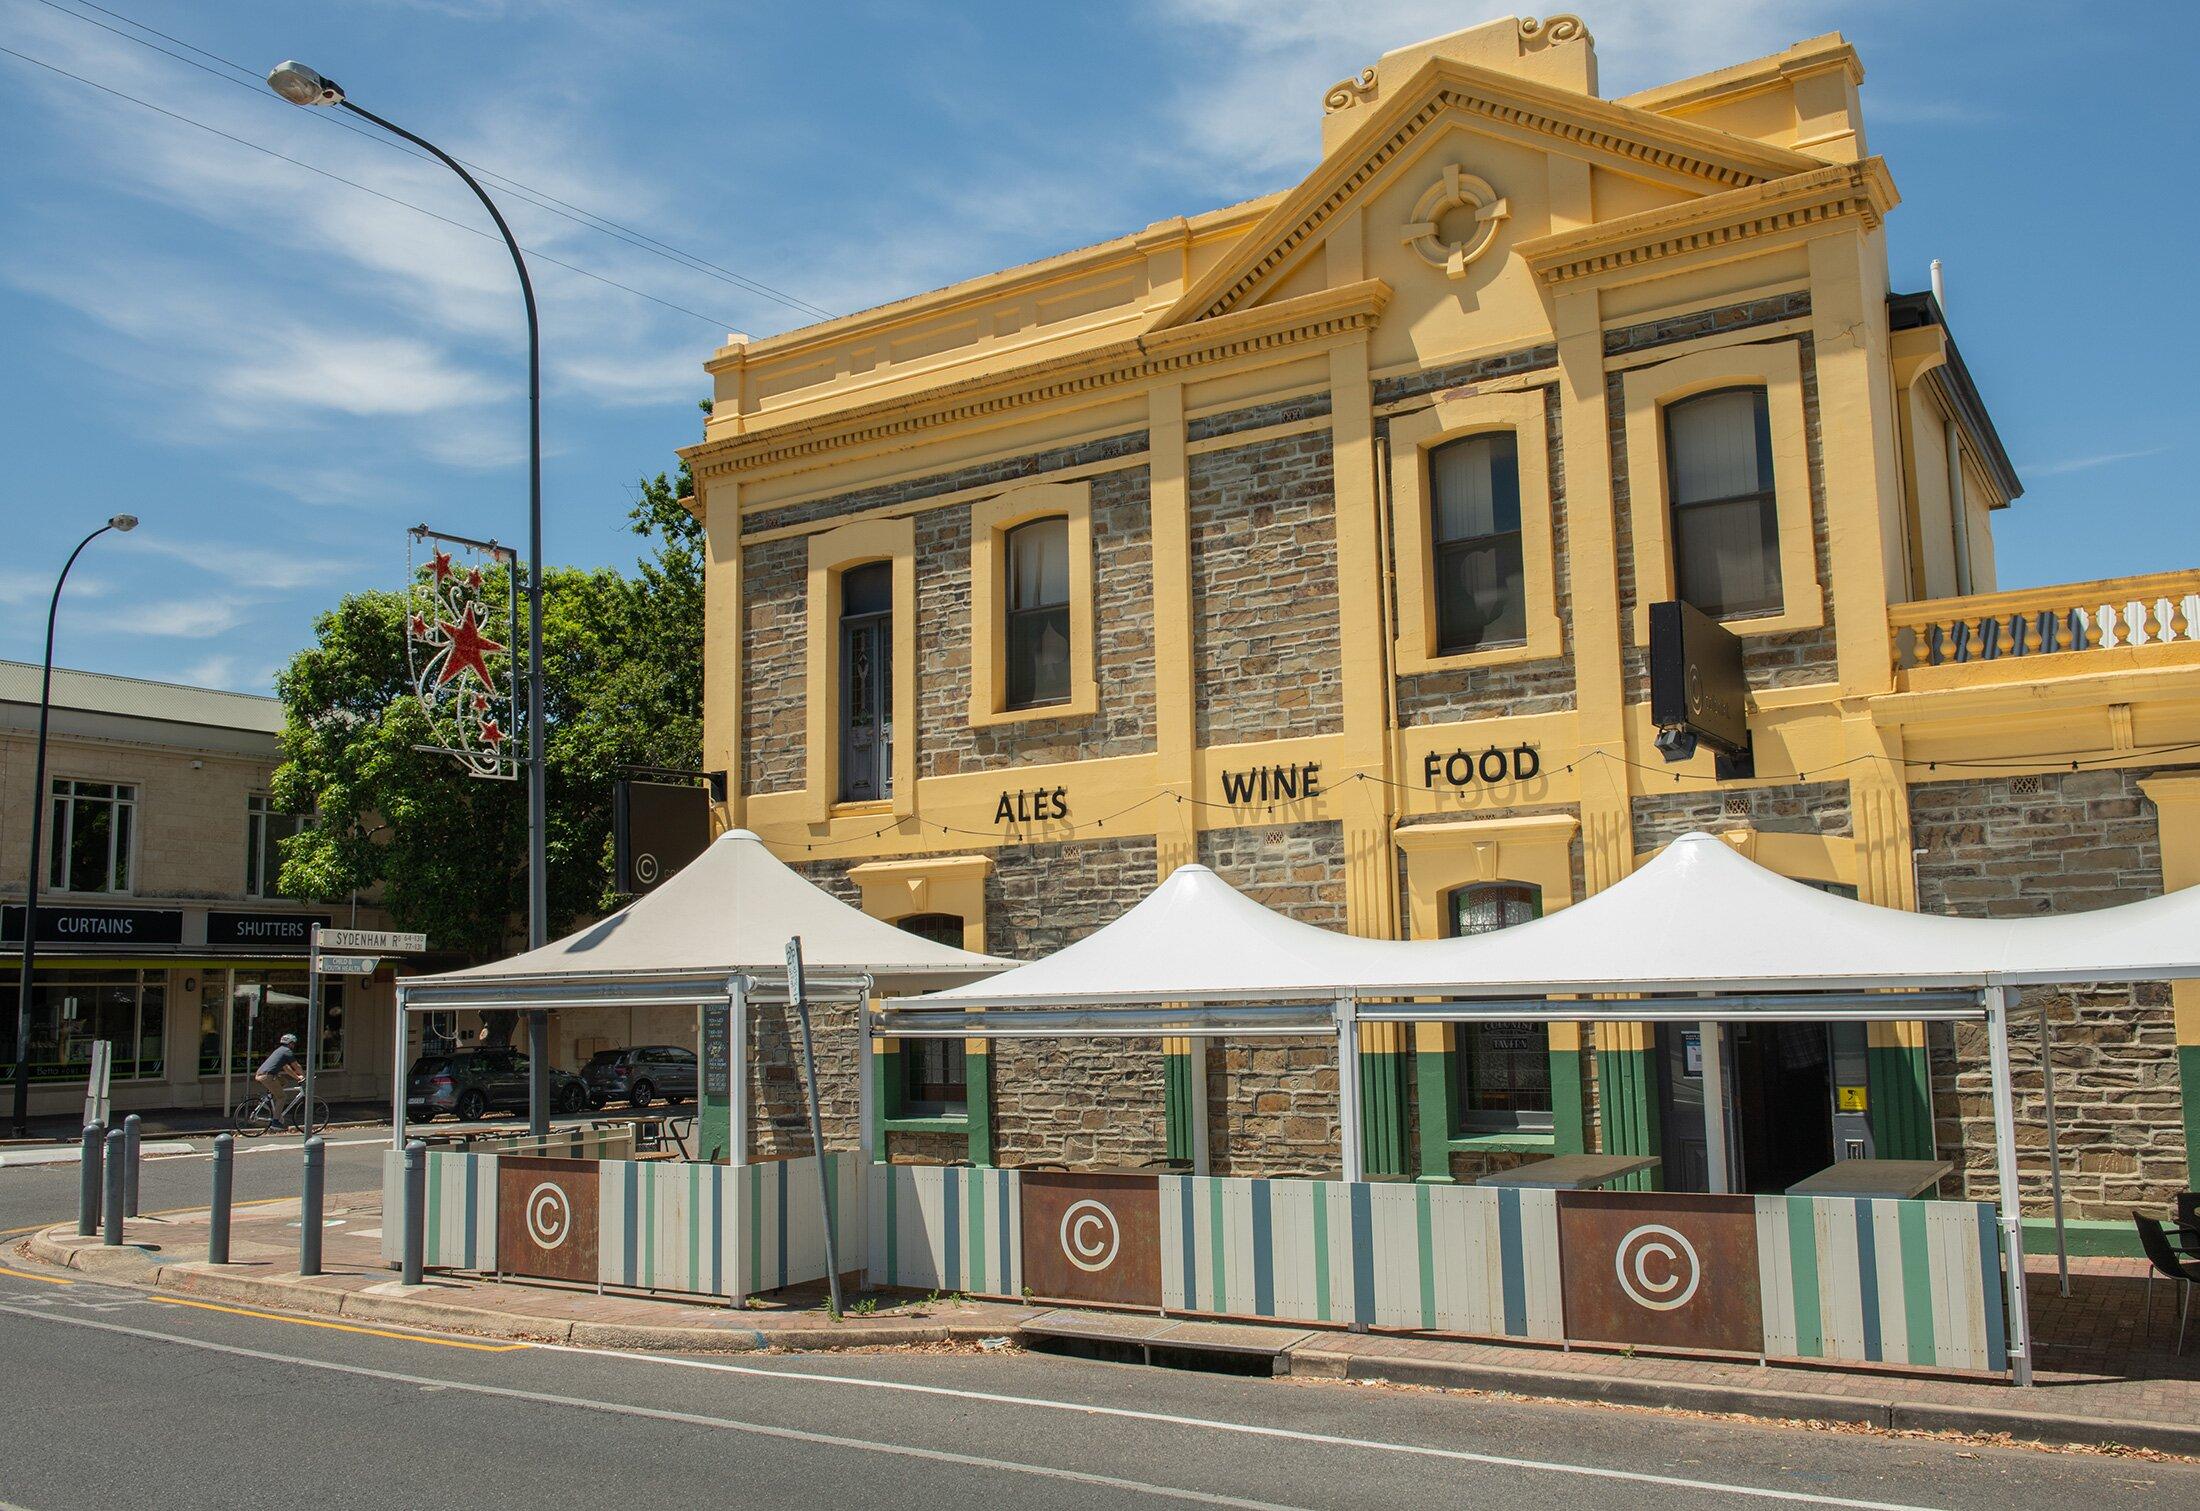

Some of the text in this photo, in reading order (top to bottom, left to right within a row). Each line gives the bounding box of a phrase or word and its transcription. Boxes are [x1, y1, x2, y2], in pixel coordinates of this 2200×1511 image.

[1424, 747, 1540, 788] FOOD
[1222, 765, 1320, 804] WINE
[994, 790, 1067, 824] ALES
[57, 917, 134, 935] CURTAINS
[237, 921, 304, 937] SHUTTERS
[336, 932, 387, 947] SYDENHAM
